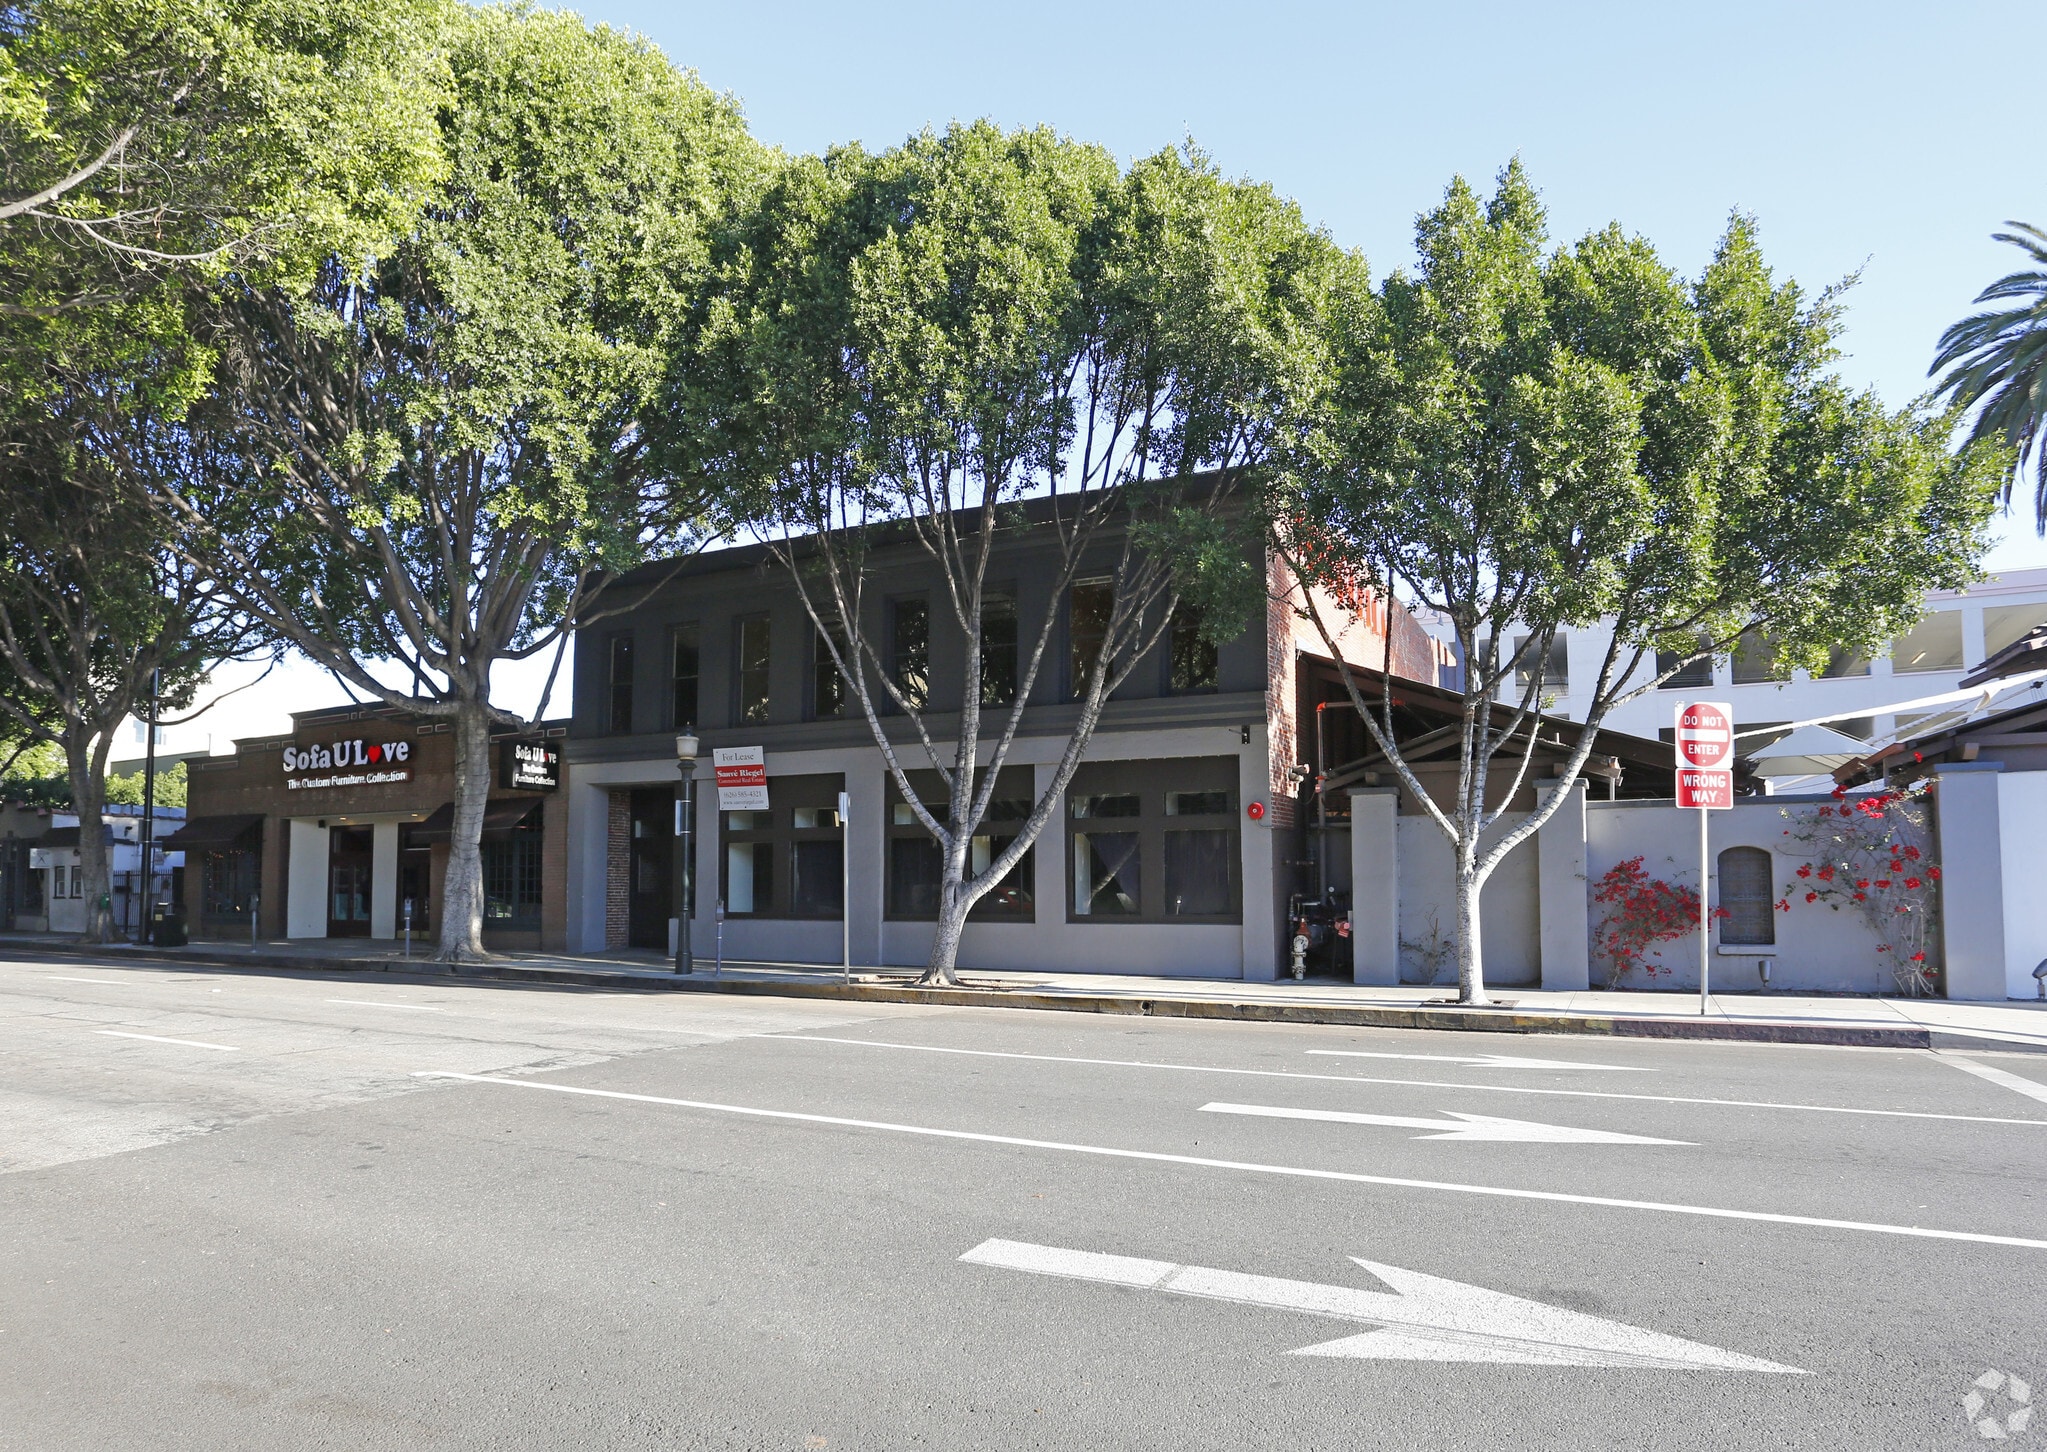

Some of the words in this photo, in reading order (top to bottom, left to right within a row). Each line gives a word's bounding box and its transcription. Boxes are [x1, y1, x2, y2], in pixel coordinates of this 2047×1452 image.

[1684, 715, 1698, 726] DO
[1702, 716, 1723, 727] NOT
[515, 744, 531, 760] Sofa
[1688, 744, 1720, 755] ENTER
[722, 753, 733, 761] For
[734, 752, 754, 761] Lease
[301, 777, 331, 789] Custom
[331, 774, 366, 786] Furniture
[366, 770, 407, 784] Collection
[739, 769, 763, 778] Riegel
[1683, 774, 1726, 788] WRONG
[1691, 790, 1718, 803] WAY
